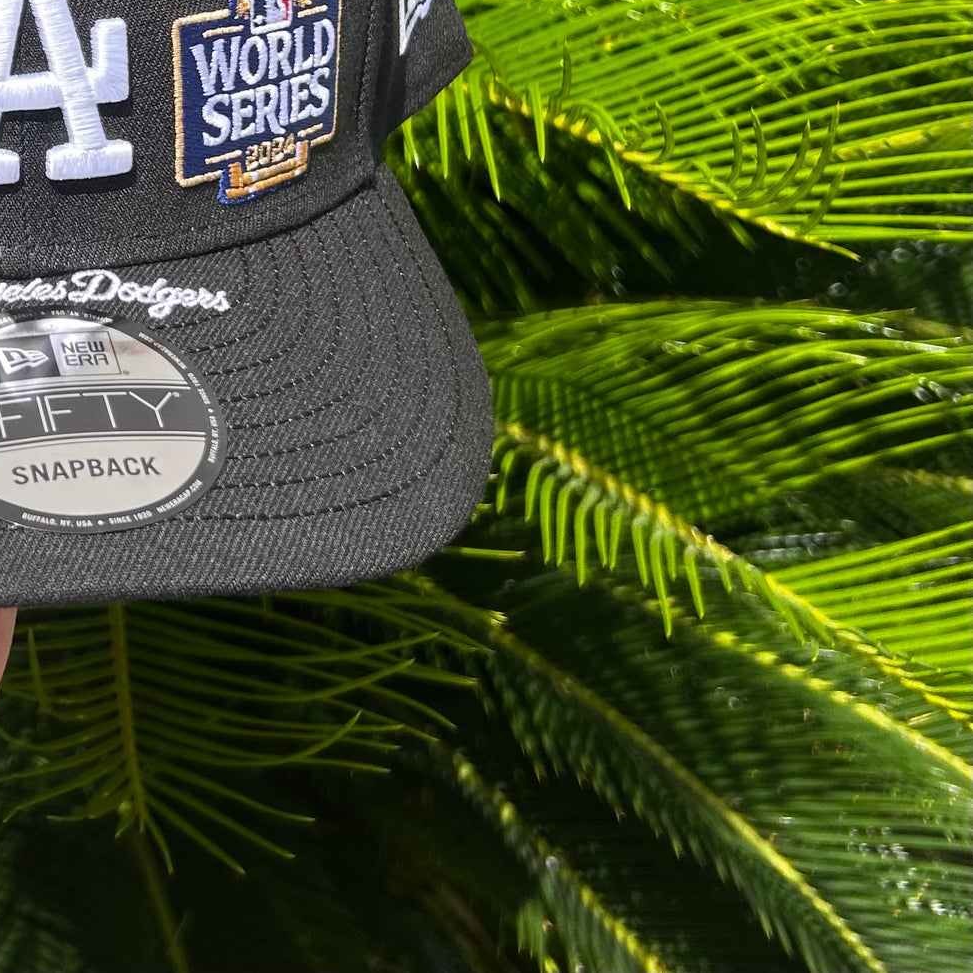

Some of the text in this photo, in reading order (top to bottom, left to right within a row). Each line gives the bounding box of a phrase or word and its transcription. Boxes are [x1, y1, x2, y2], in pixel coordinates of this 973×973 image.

[190, 19, 335, 95] WORLD
[201, 67, 329, 147] SERIES
[245, 132, 296, 171] 2024
[68, 268, 229, 319] Dodgers
[60, 339, 105, 354] NEW
[64, 353, 110, 368] ERA
[11, 455, 162, 485] SNAPBACK
[76, 519, 93, 528] USA
[108, 513, 133, 525] SINCE
[133, 510, 152, 521] 1920
